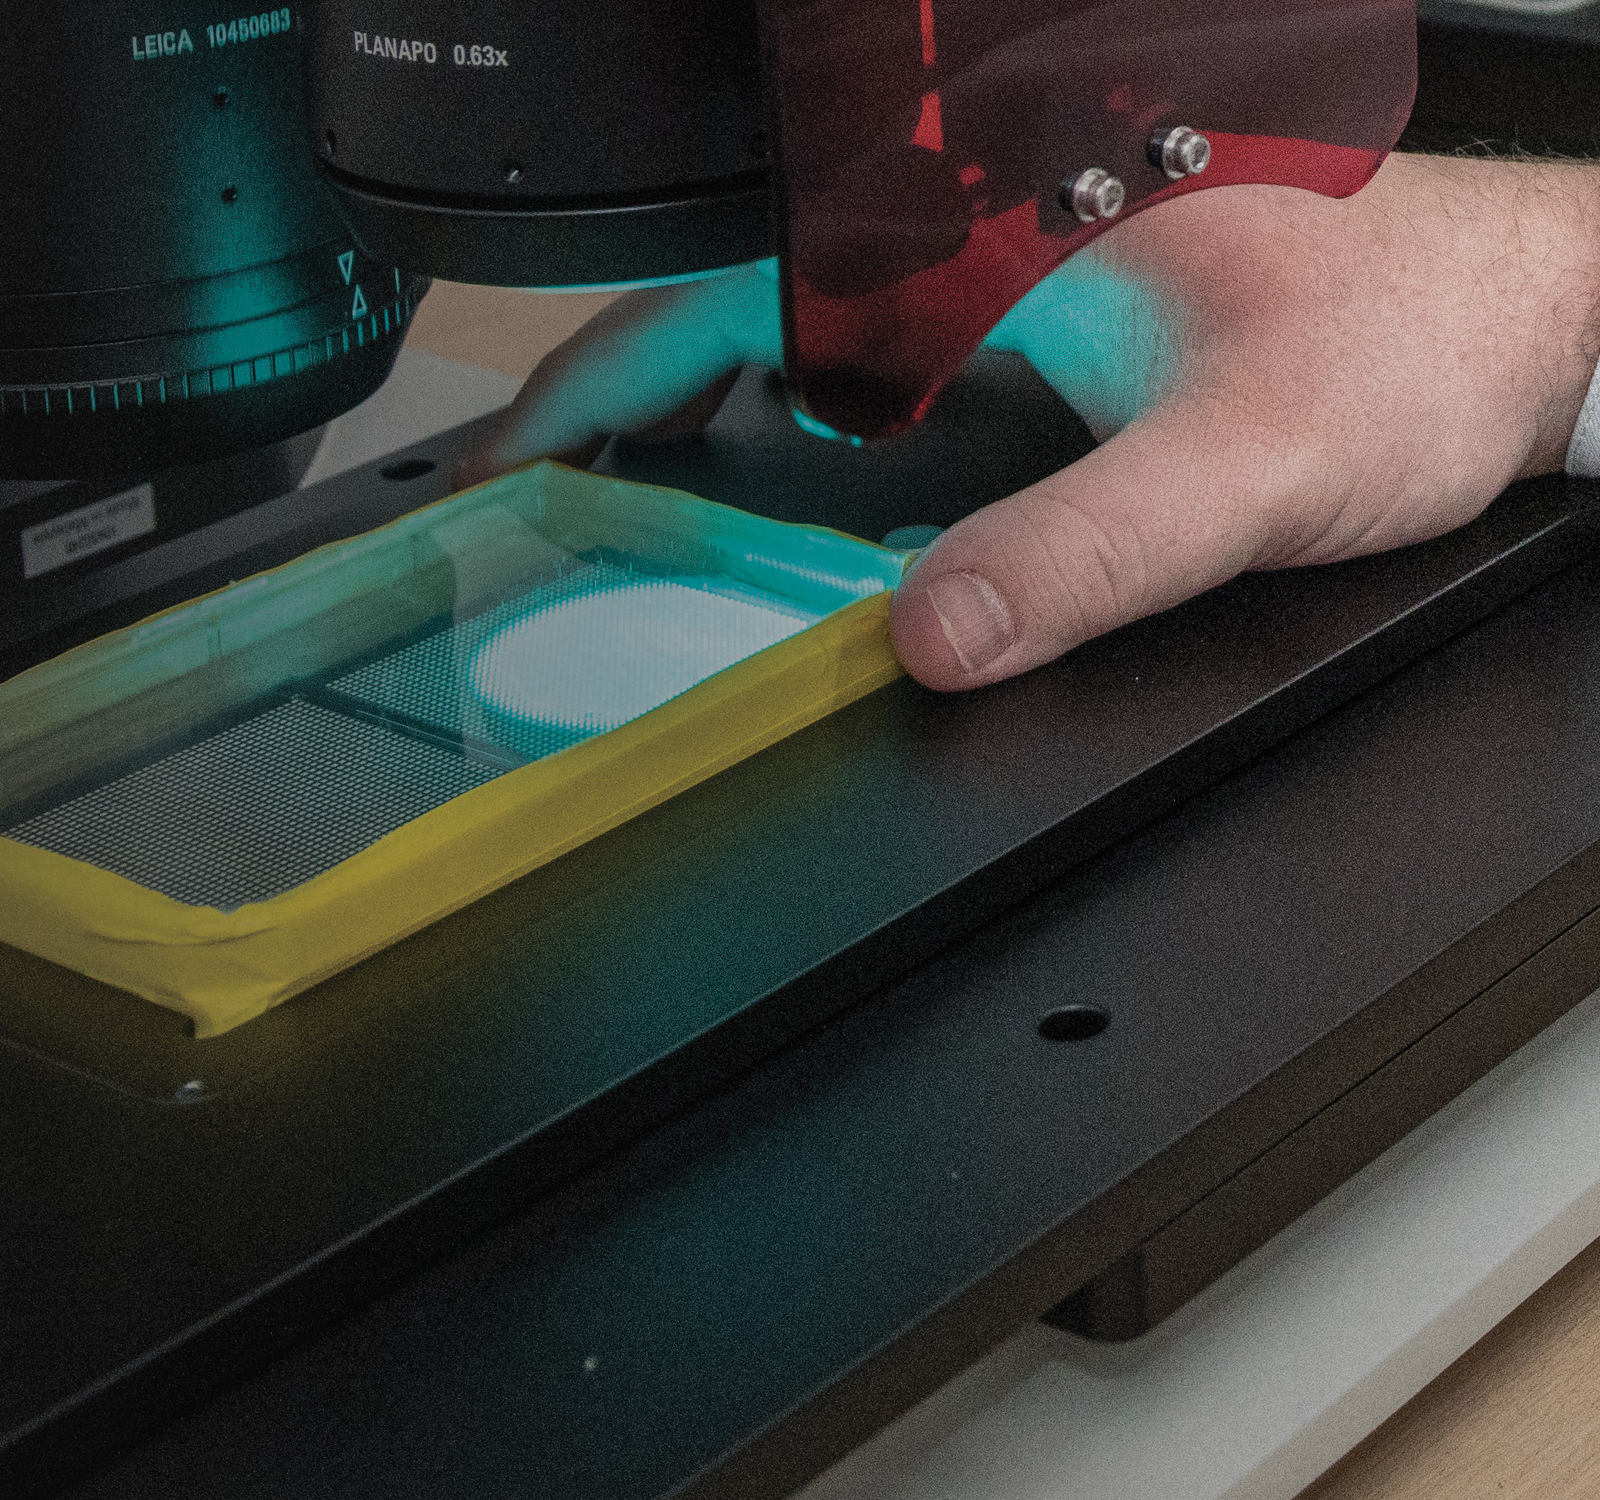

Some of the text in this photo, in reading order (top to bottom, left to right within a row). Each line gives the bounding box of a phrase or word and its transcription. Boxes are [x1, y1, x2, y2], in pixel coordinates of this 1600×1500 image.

[132, 28, 194, 61] LEICA
[353, 30, 510, 67] PLANAPO 0.63x
